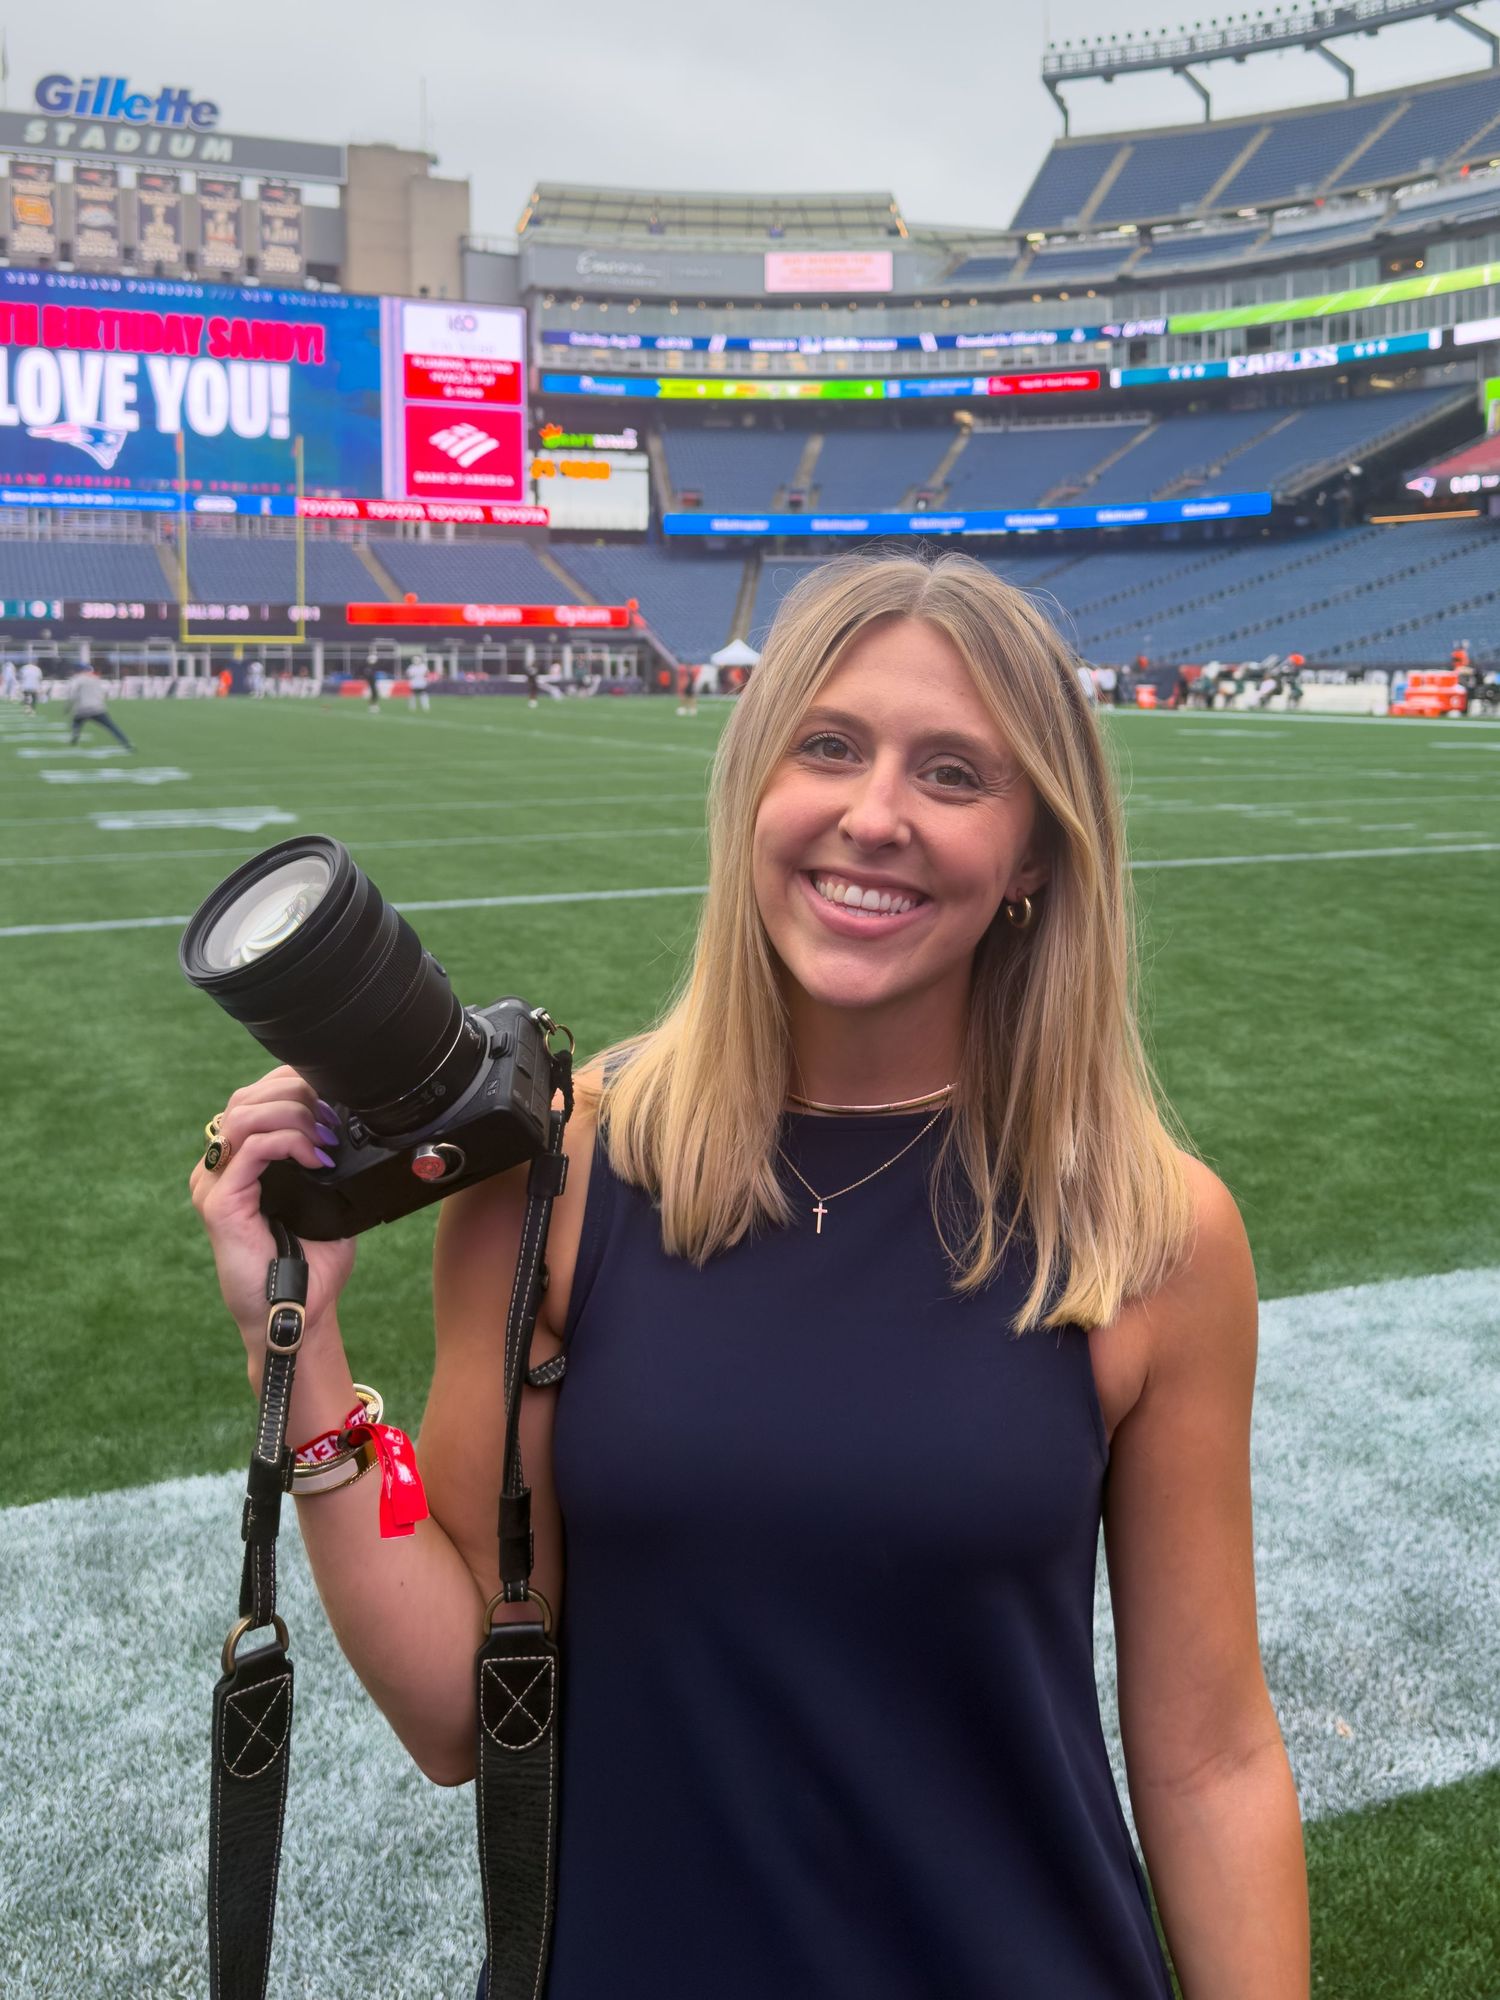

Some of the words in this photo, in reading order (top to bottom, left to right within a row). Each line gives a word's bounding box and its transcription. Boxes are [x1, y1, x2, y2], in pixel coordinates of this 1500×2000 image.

[35, 75, 219, 131] Gillette
[24, 119, 233, 162] STADIUM
[5, 271, 40, 286] NEW
[46, 273, 121, 293] ENGLAND
[126, 280, 204, 299] PATRIOTS
[42, 304, 204, 356] BIRTHDAY
[207, 316, 325, 365] SANDY!
[145, 355, 290, 439] YOU!
